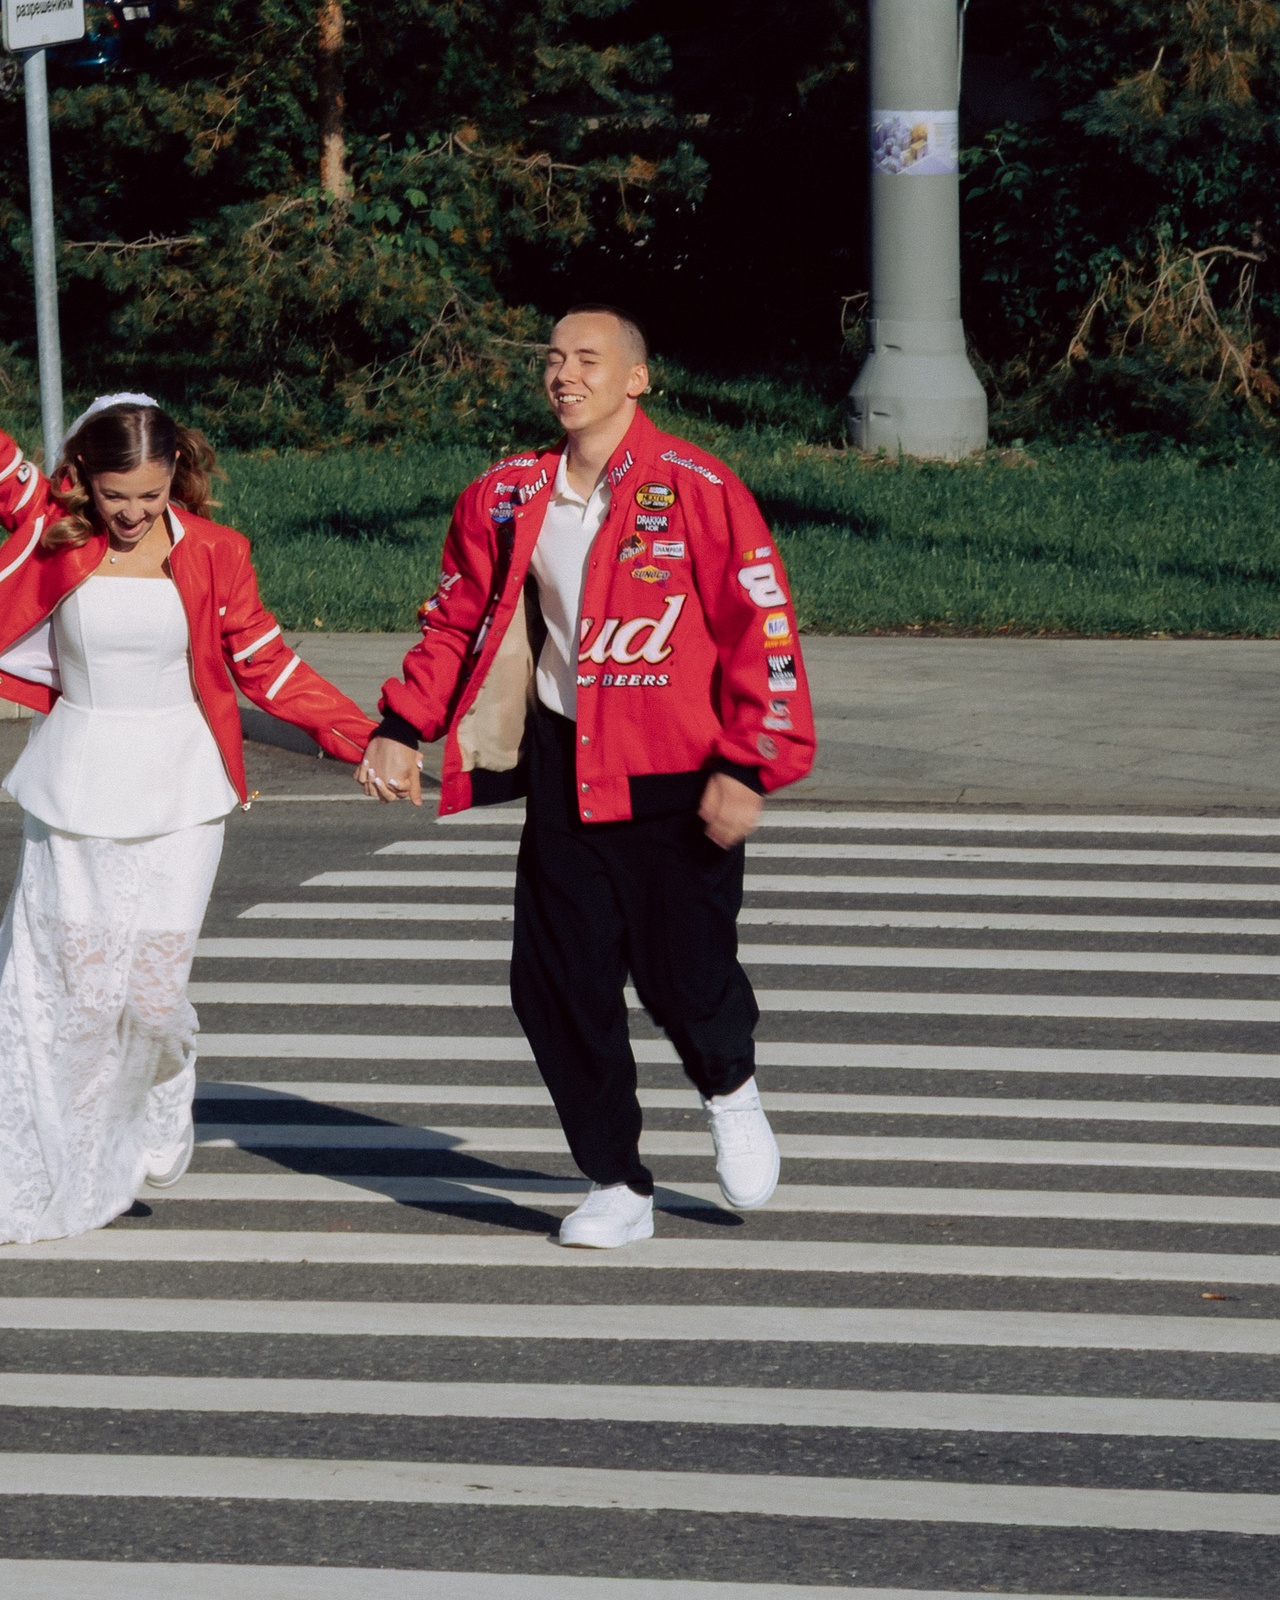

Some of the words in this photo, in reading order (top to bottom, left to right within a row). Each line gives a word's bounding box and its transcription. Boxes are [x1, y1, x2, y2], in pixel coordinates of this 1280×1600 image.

[611, 450, 634, 486] Bud
[660, 449, 724, 485] Budweiser
[519, 468, 548, 504] Bud
[636, 514, 668, 527] DRAKKAR
[633, 570, 669, 580] SUNOCO
[737, 562, 788, 608] 8
[601, 673, 669, 687] BEERS
